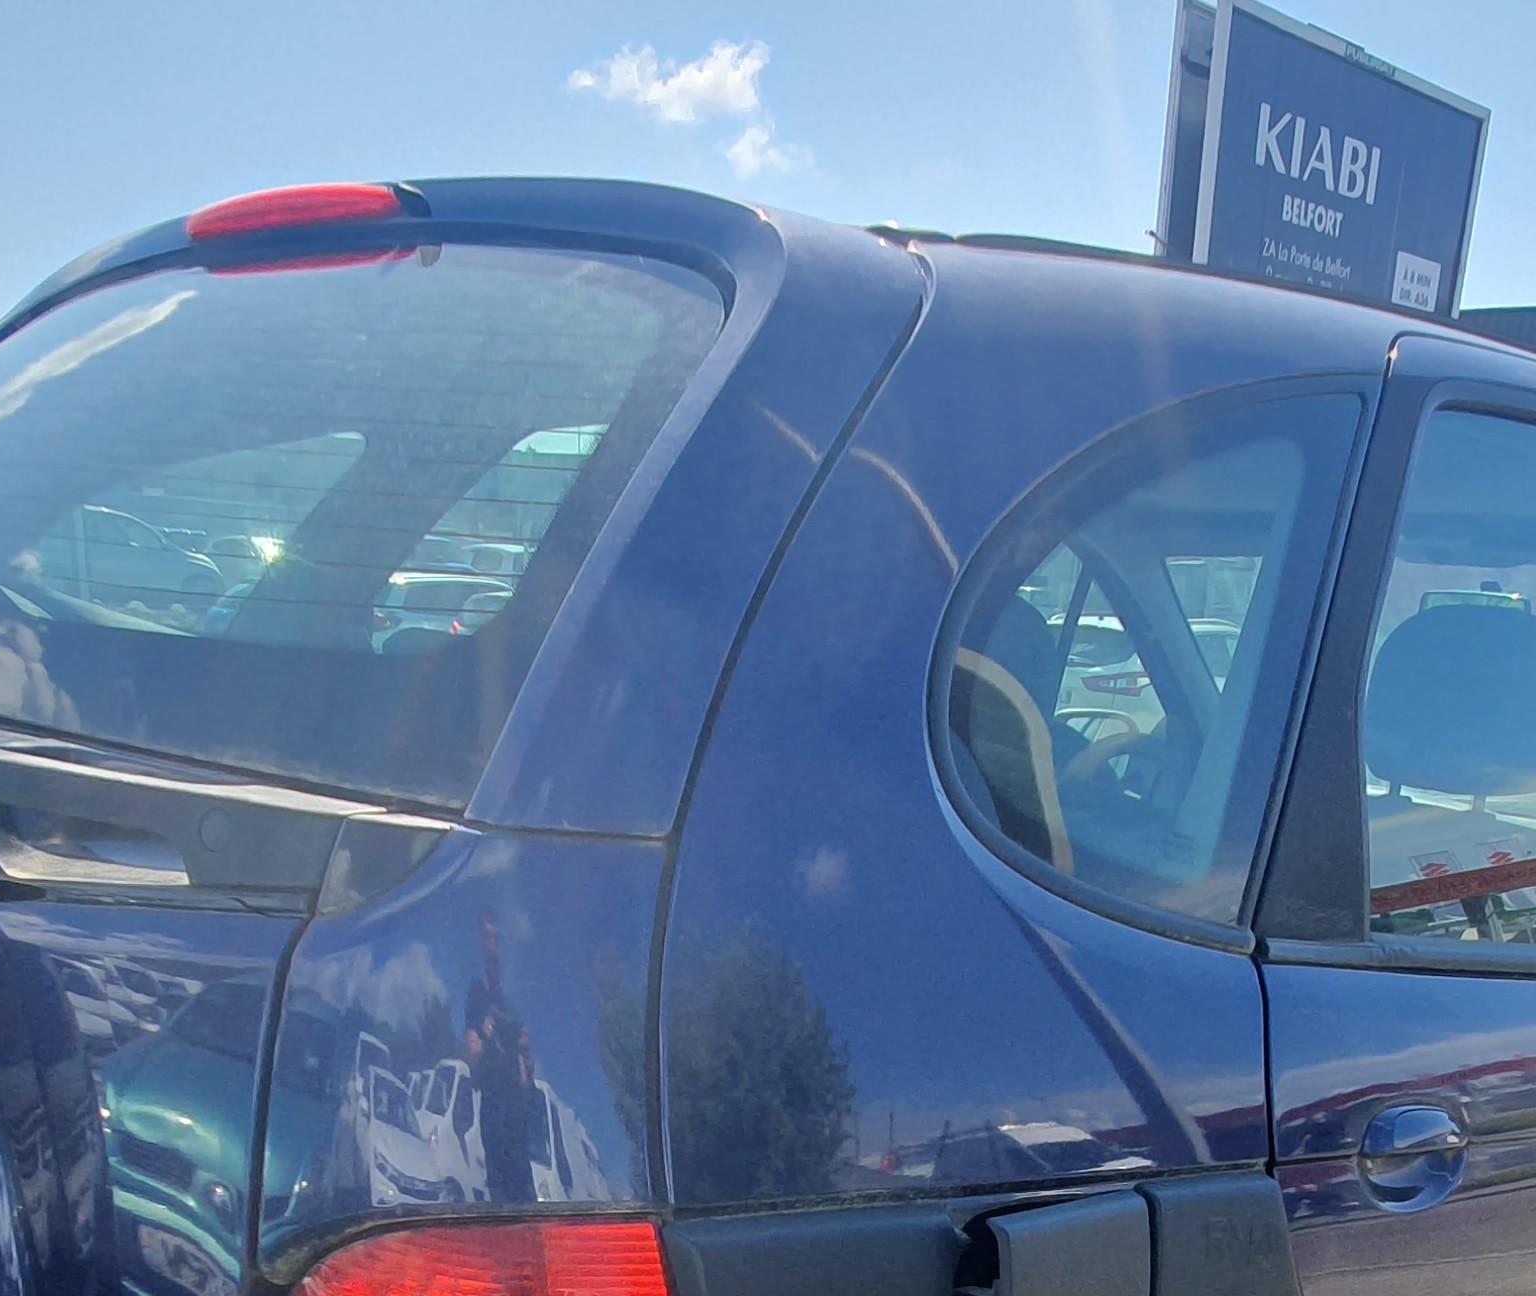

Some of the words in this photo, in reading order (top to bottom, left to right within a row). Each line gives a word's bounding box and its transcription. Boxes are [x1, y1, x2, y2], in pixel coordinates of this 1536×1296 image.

[1255, 102, 1382, 206] KIABI
[1282, 194, 1344, 239] BELFORT
[1262, 237, 1276, 258] ZA
[1277, 241, 1289, 262] La
[1290, 244, 1312, 269] Porte
[1312, 251, 1324, 273] de
[1325, 255, 1352, 280] Belfort
